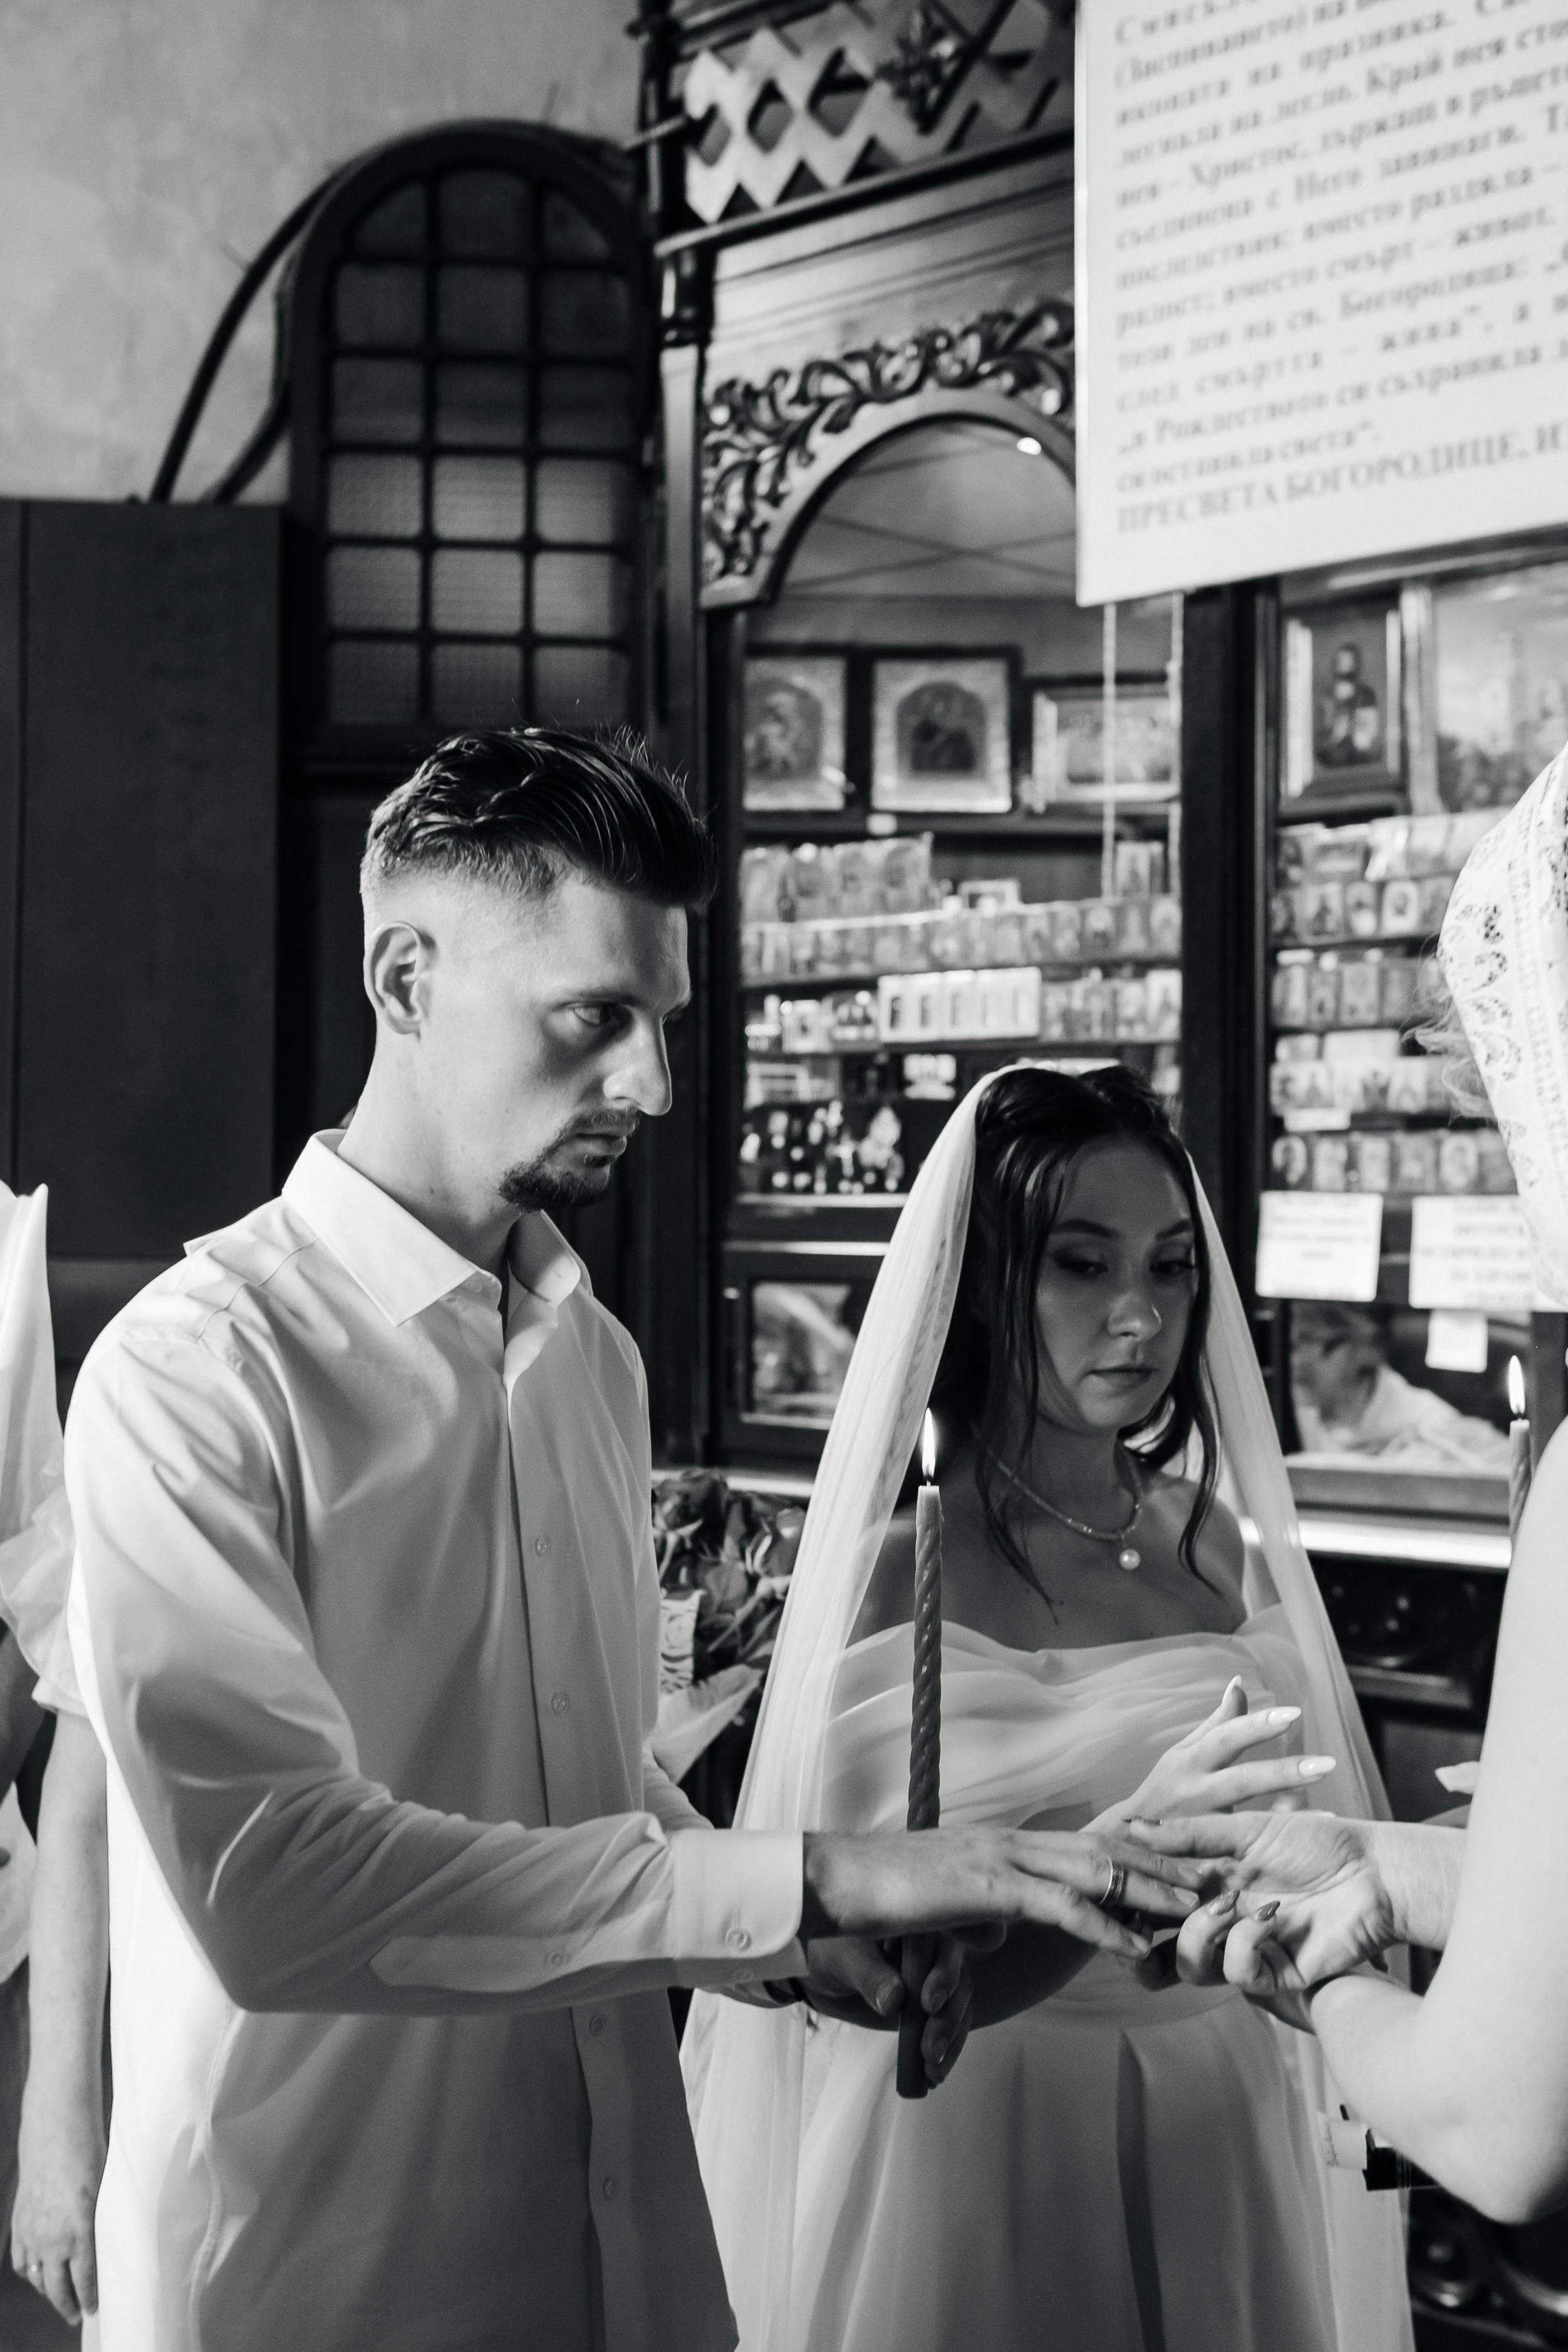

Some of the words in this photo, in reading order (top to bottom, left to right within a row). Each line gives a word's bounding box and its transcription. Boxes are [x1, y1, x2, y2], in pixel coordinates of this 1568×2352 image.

[1230, 110, 1262, 134] на
[1366, 49, 1441, 96] Край
[1248, 61, 1281, 87] на
[1470, 63, 1568, 117] ръцет
[1326, 241, 1413, 279] смърт
[1243, 320, 1275, 341] на
[1196, 351, 1322, 393] смъртта
[1119, 483, 1278, 531] ПРЕСВЕТА
